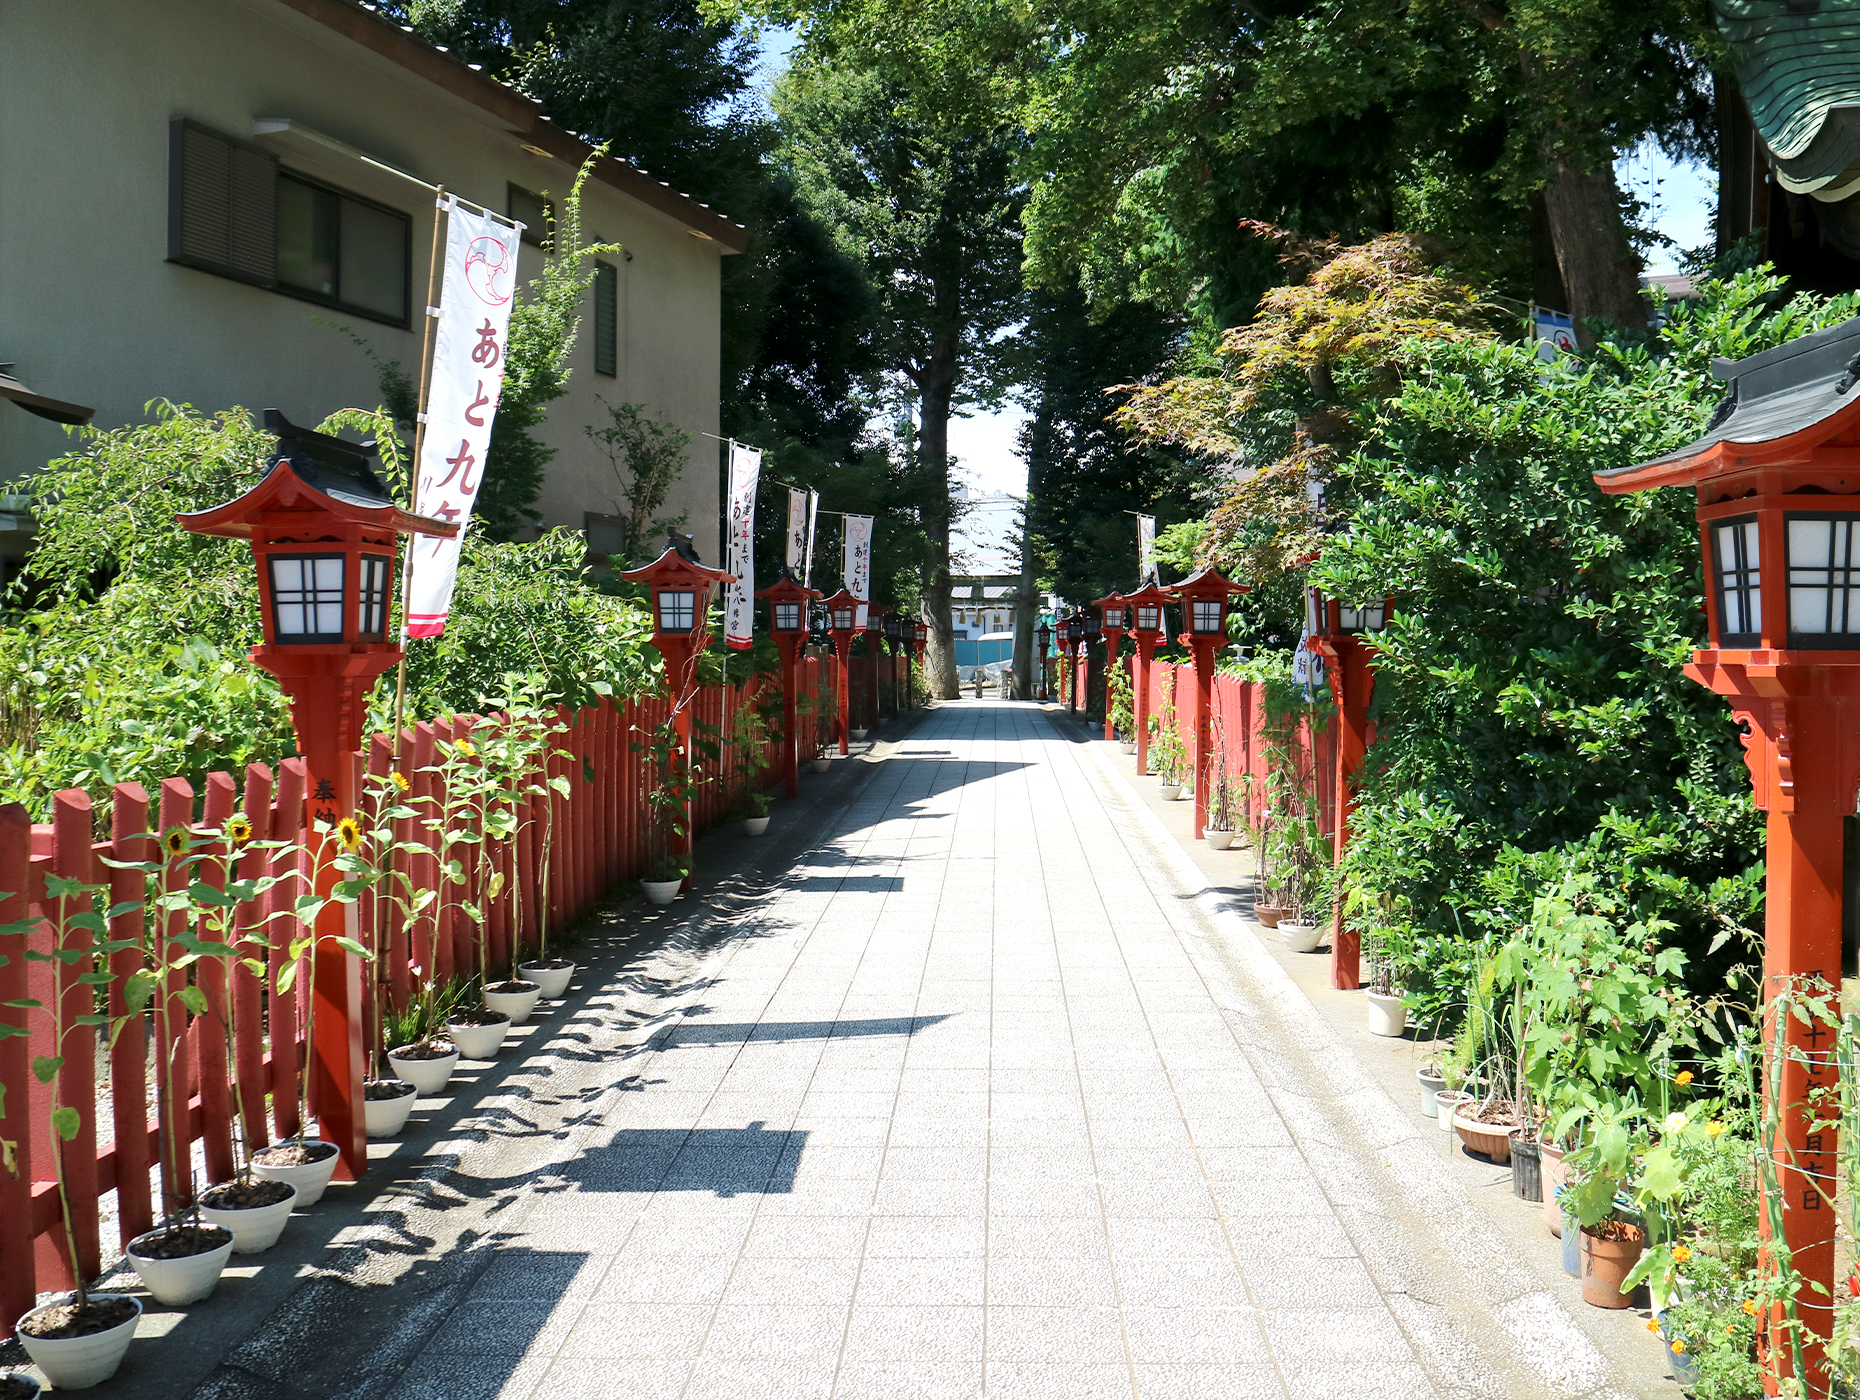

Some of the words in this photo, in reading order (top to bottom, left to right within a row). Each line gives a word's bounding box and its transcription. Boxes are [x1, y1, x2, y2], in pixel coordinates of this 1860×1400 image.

[740, 491, 753, 564] 創建千年まで
[851, 544, 863, 600] あと九
